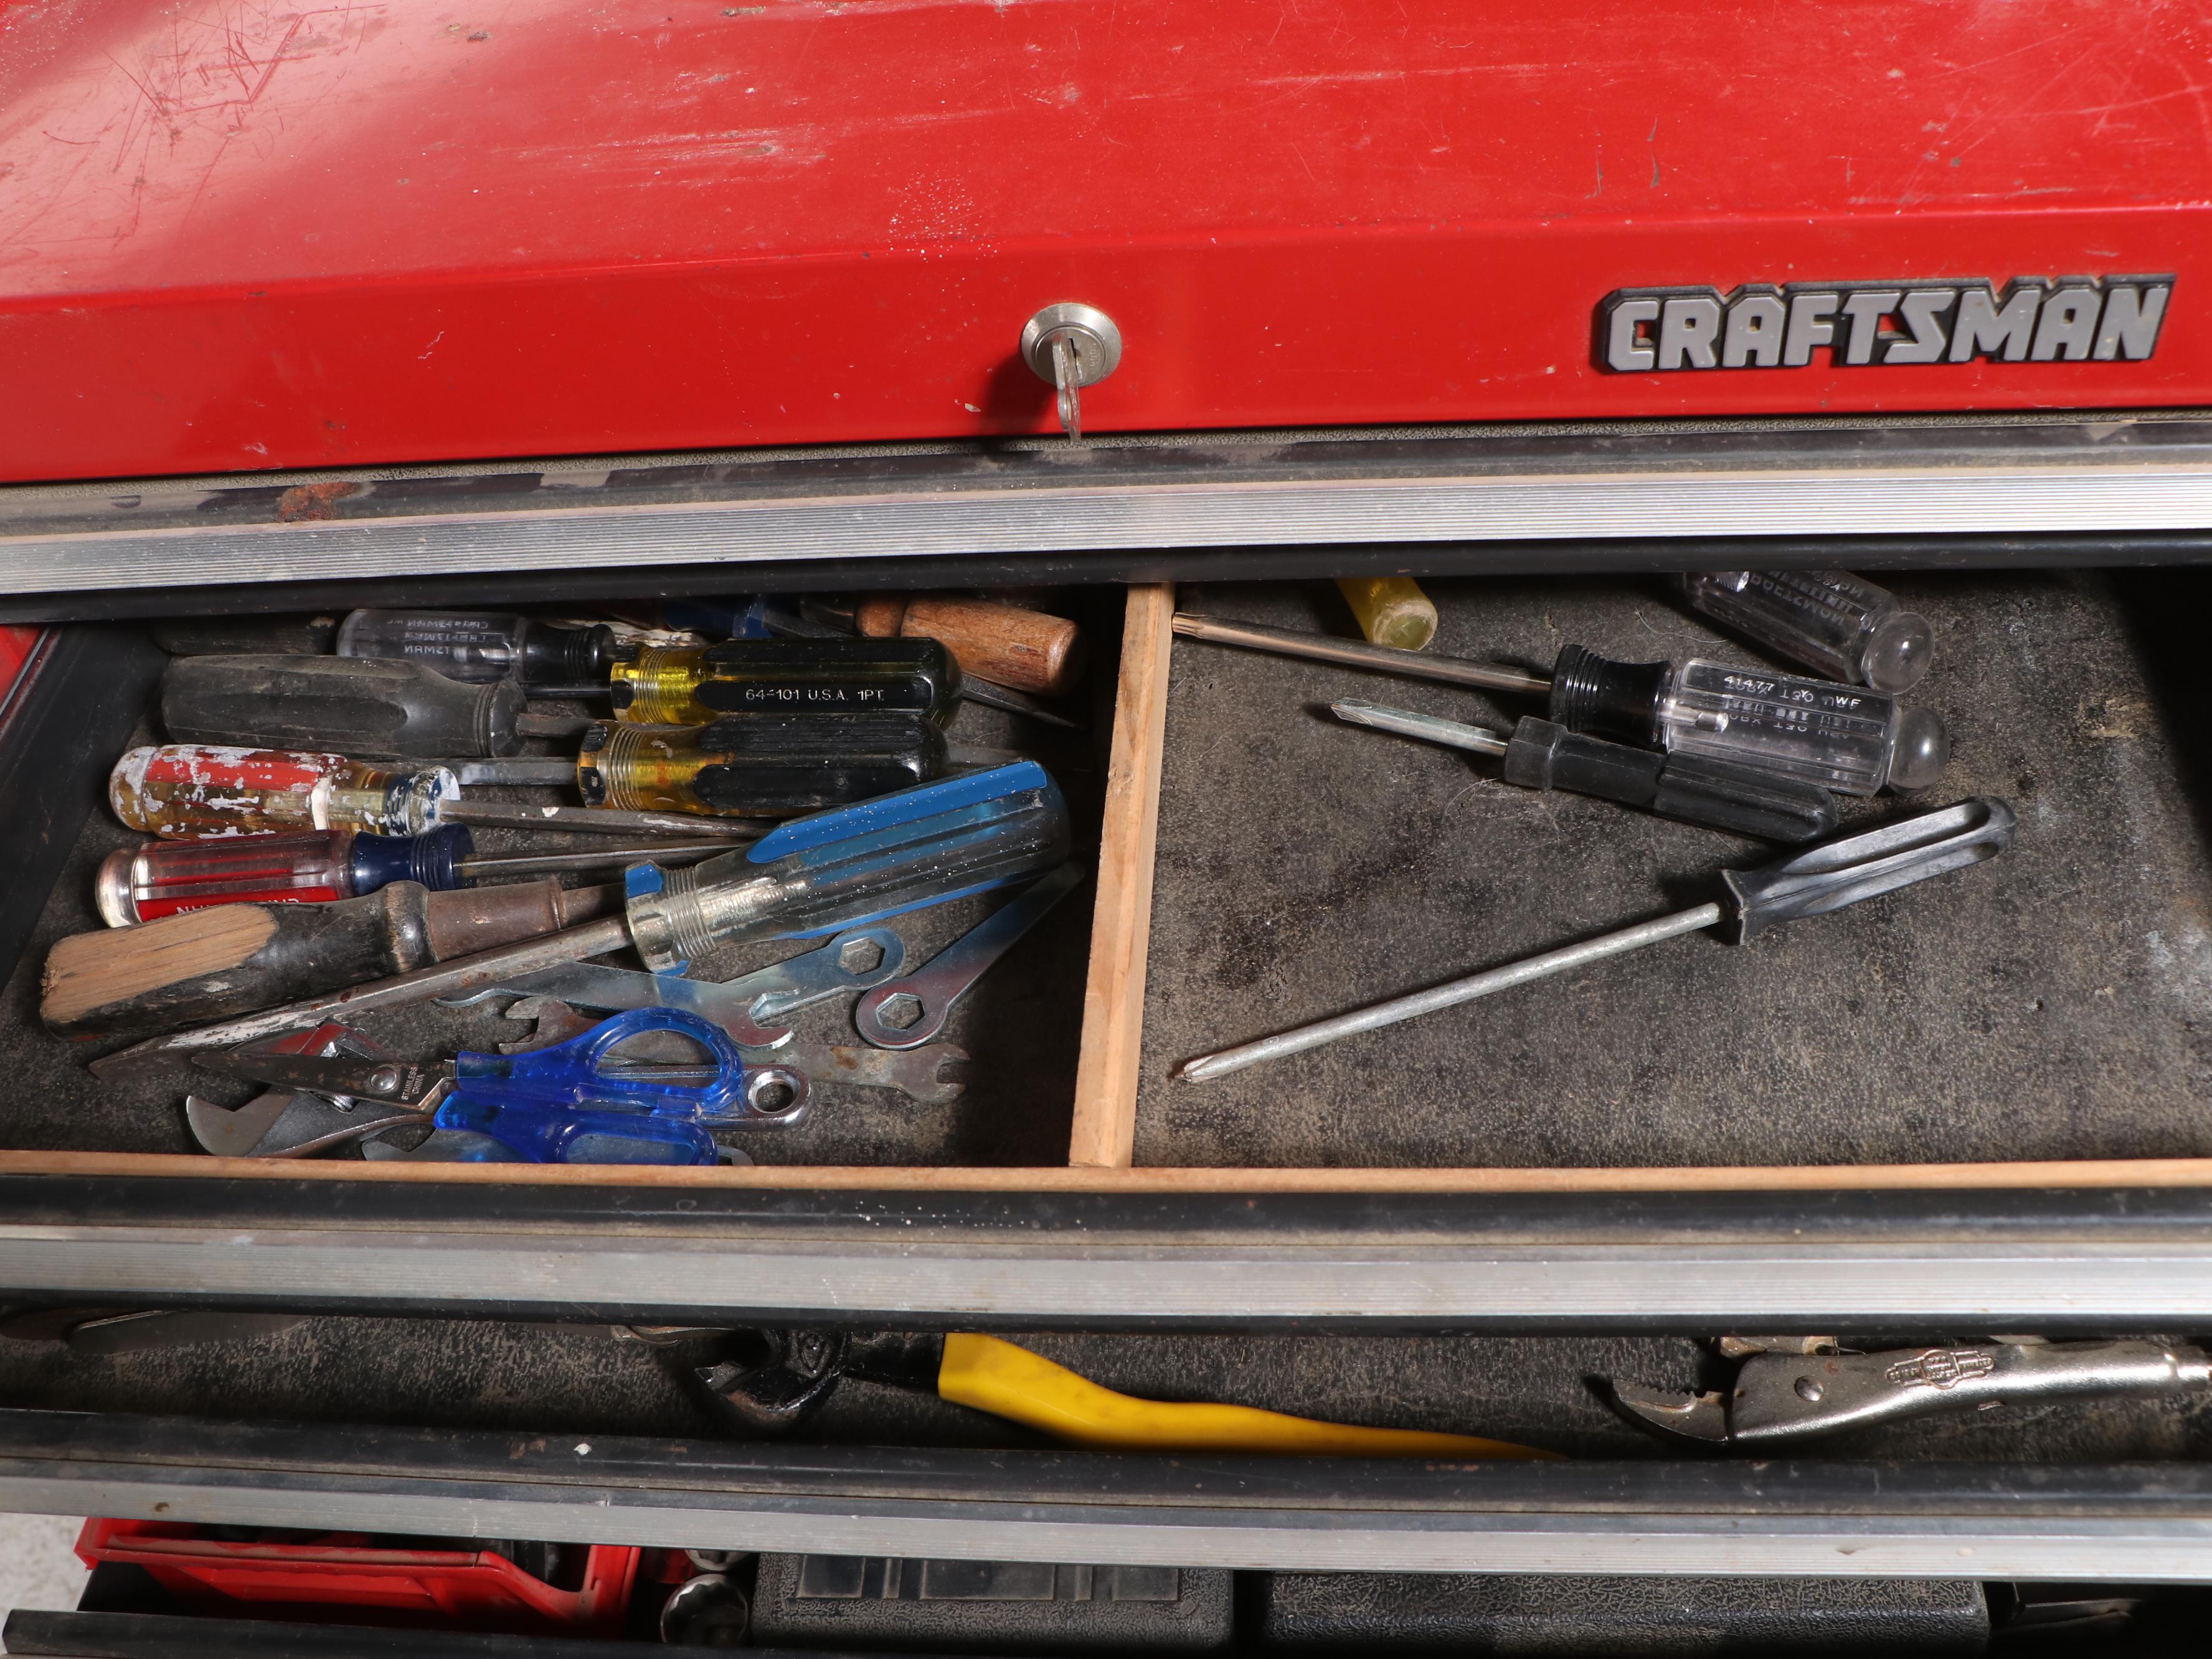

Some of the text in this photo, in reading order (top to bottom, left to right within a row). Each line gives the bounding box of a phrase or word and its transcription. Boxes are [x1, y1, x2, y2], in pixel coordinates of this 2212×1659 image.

[1607, 285, 2170, 372] CRAFTSMAN
[1724, 674, 1775, 692] 41477
[745, 689, 800, 701] 64-101
[808, 689, 849, 701] U.S.A.
[401, 1067, 418, 1100] STAINLESS
[412, 1074, 425, 1094] CHINA
